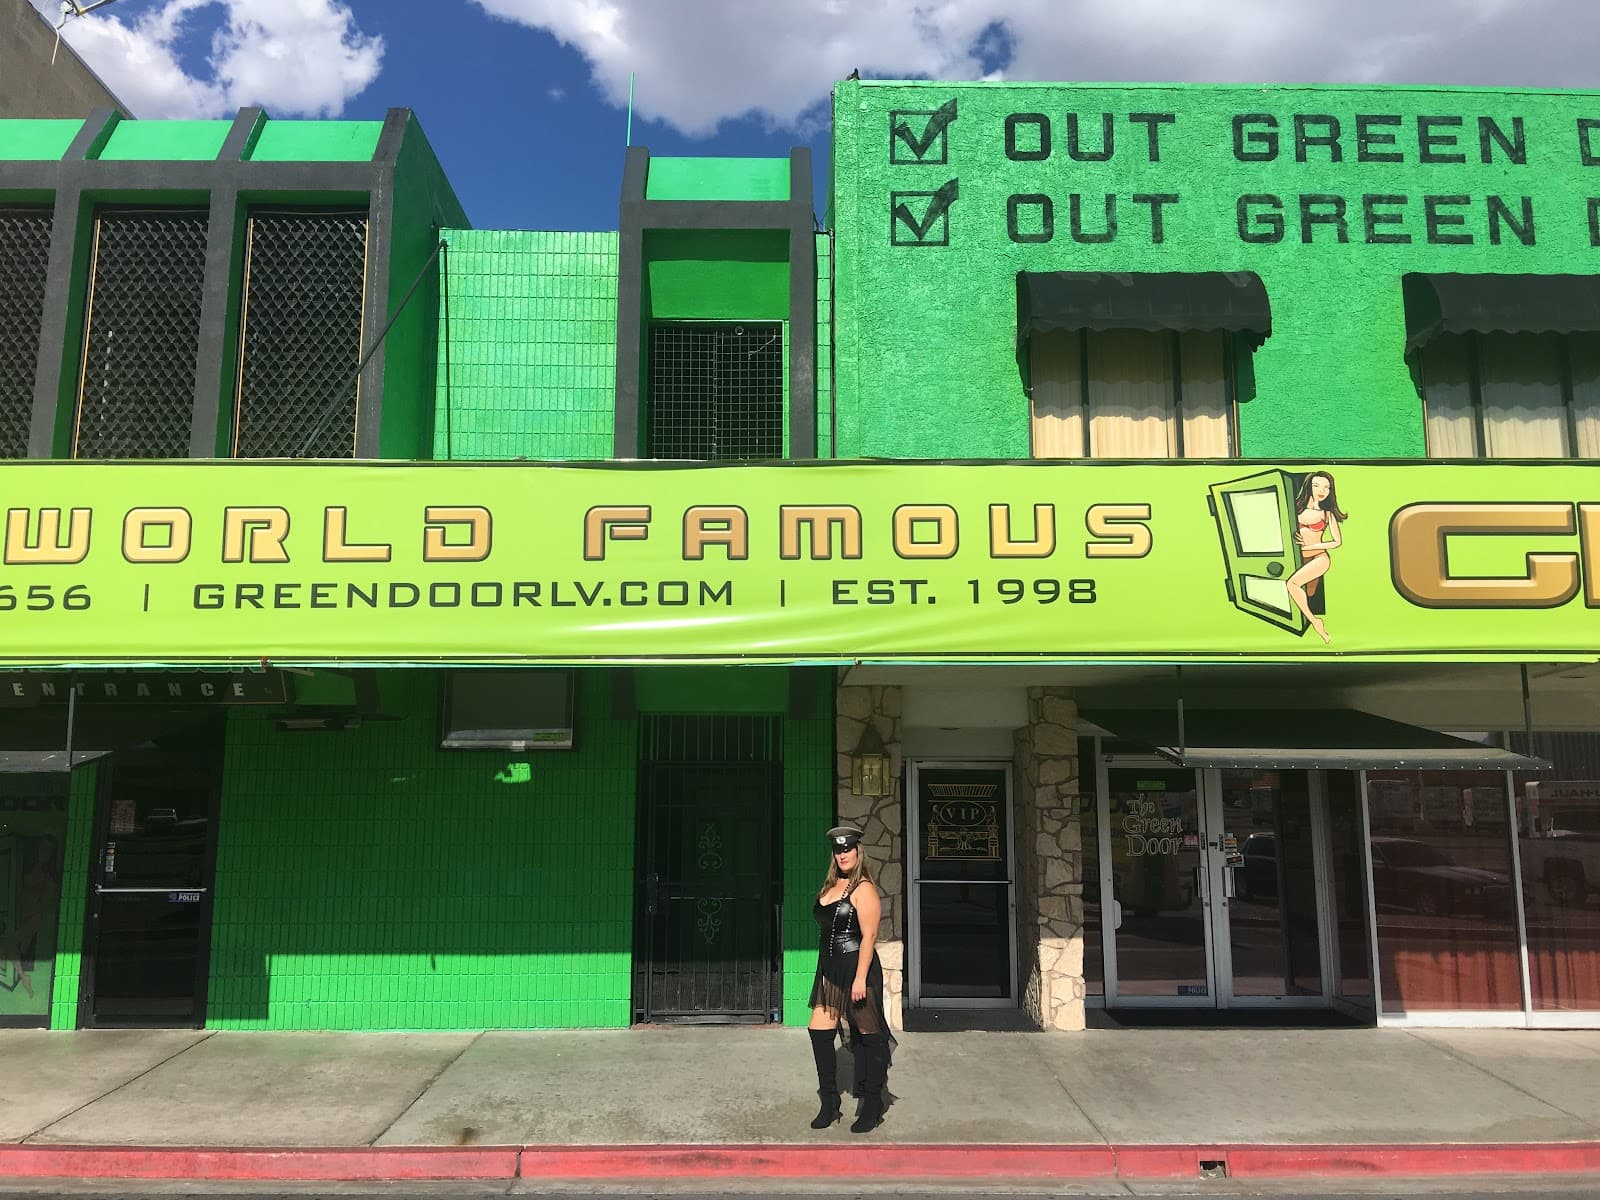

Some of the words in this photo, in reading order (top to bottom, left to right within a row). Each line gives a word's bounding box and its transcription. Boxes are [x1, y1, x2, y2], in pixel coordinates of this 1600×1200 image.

[1005, 113, 1176, 162] OUT
[1232, 114, 1527, 165] GREEN
[1007, 194, 1180, 244] OUT
[1237, 194, 1537, 246] GREEN
[3, 505, 494, 566] WORLD
[583, 502, 1154, 562] FAMOUS
[1390, 501, 1600, 610] G
[0, 584, 91, 611] 656
[194, 580, 732, 610] GREENDOORLV.COM
[833, 579, 936, 606] EST.
[967, 578, 1097, 605] 1998
[12, 681, 245, 698] ENTRANCE
[946, 807, 980, 820] VIP
[1126, 792, 1156, 817] The
[1122, 814, 1183, 834] Green
[1125, 833, 1183, 857] Door
[178, 893, 200, 903] POLICE
